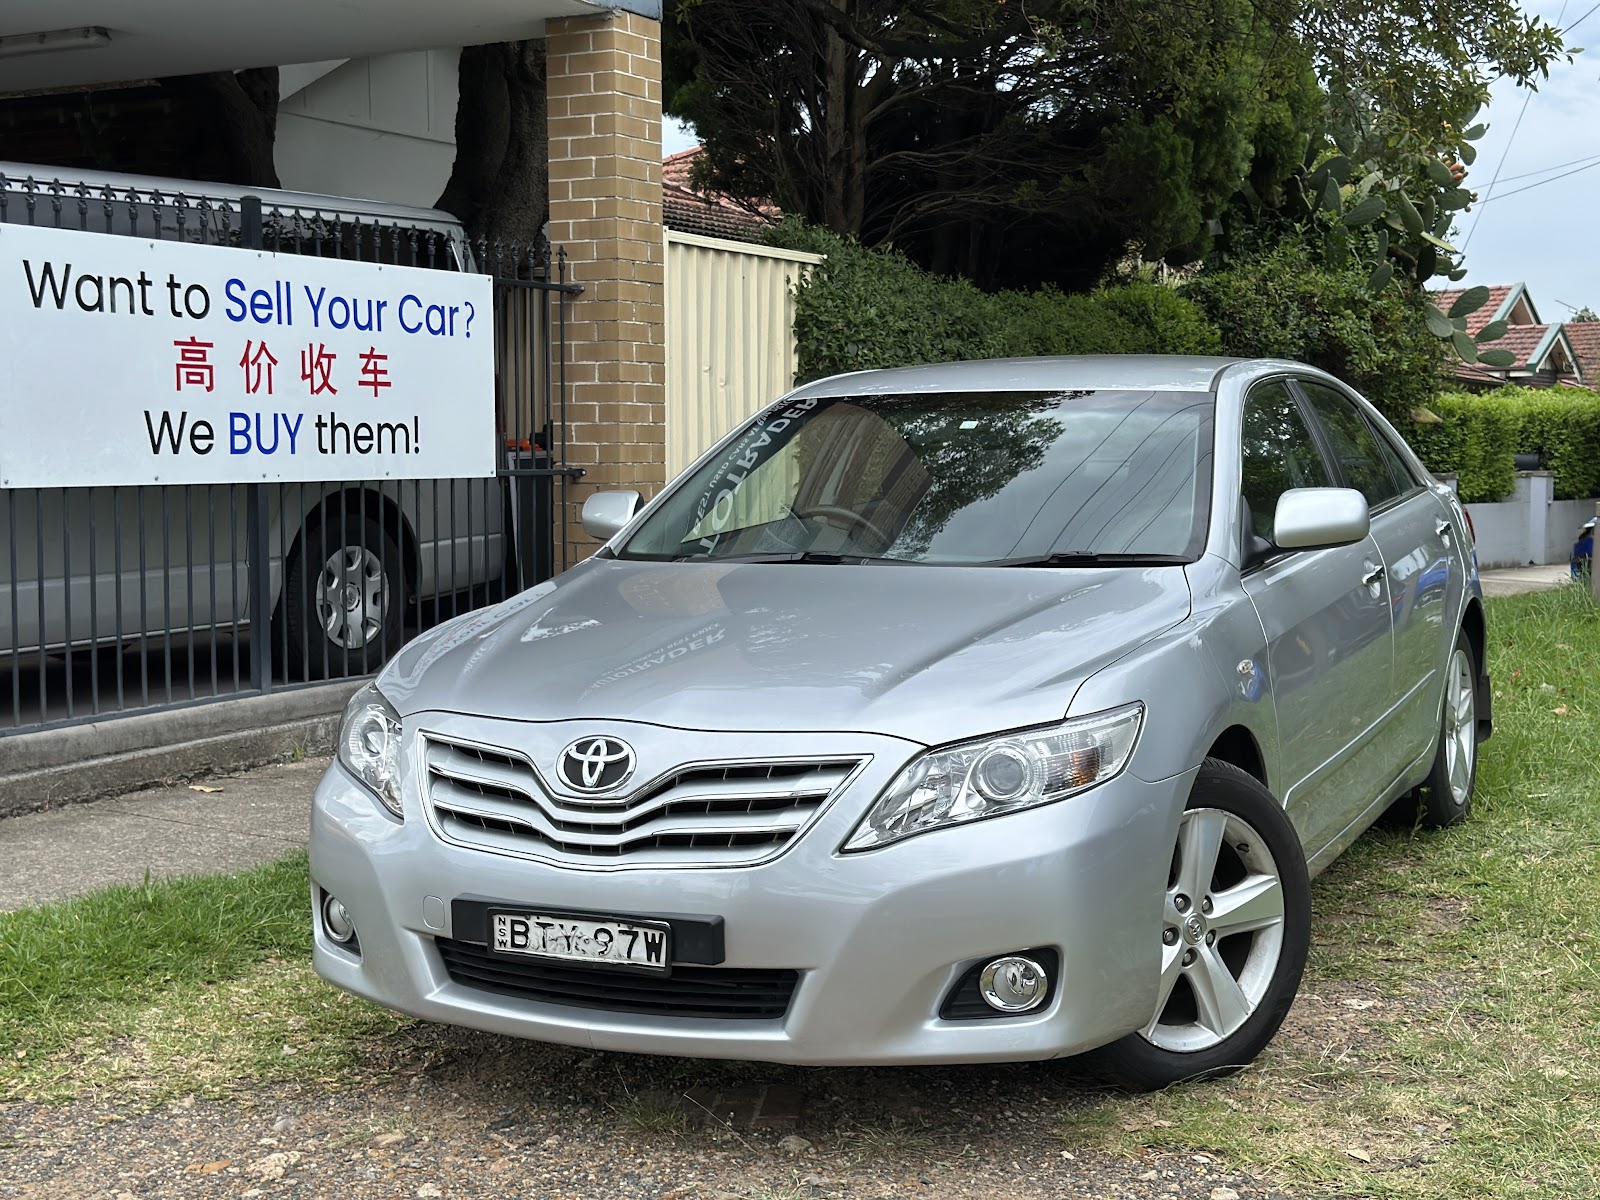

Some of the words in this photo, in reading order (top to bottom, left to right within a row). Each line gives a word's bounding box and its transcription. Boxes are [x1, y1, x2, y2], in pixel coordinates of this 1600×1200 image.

[23, 260, 154, 316] Want
[166, 274, 210, 319] to
[225, 279, 292, 325] Sell
[304, 285, 387, 332] Your
[399, 295, 475, 338] Car?
[174, 336, 391, 397] 高价收车
[144, 410, 214, 455] We
[230, 412, 303, 454] BUY
[315, 412, 420, 454] them!
